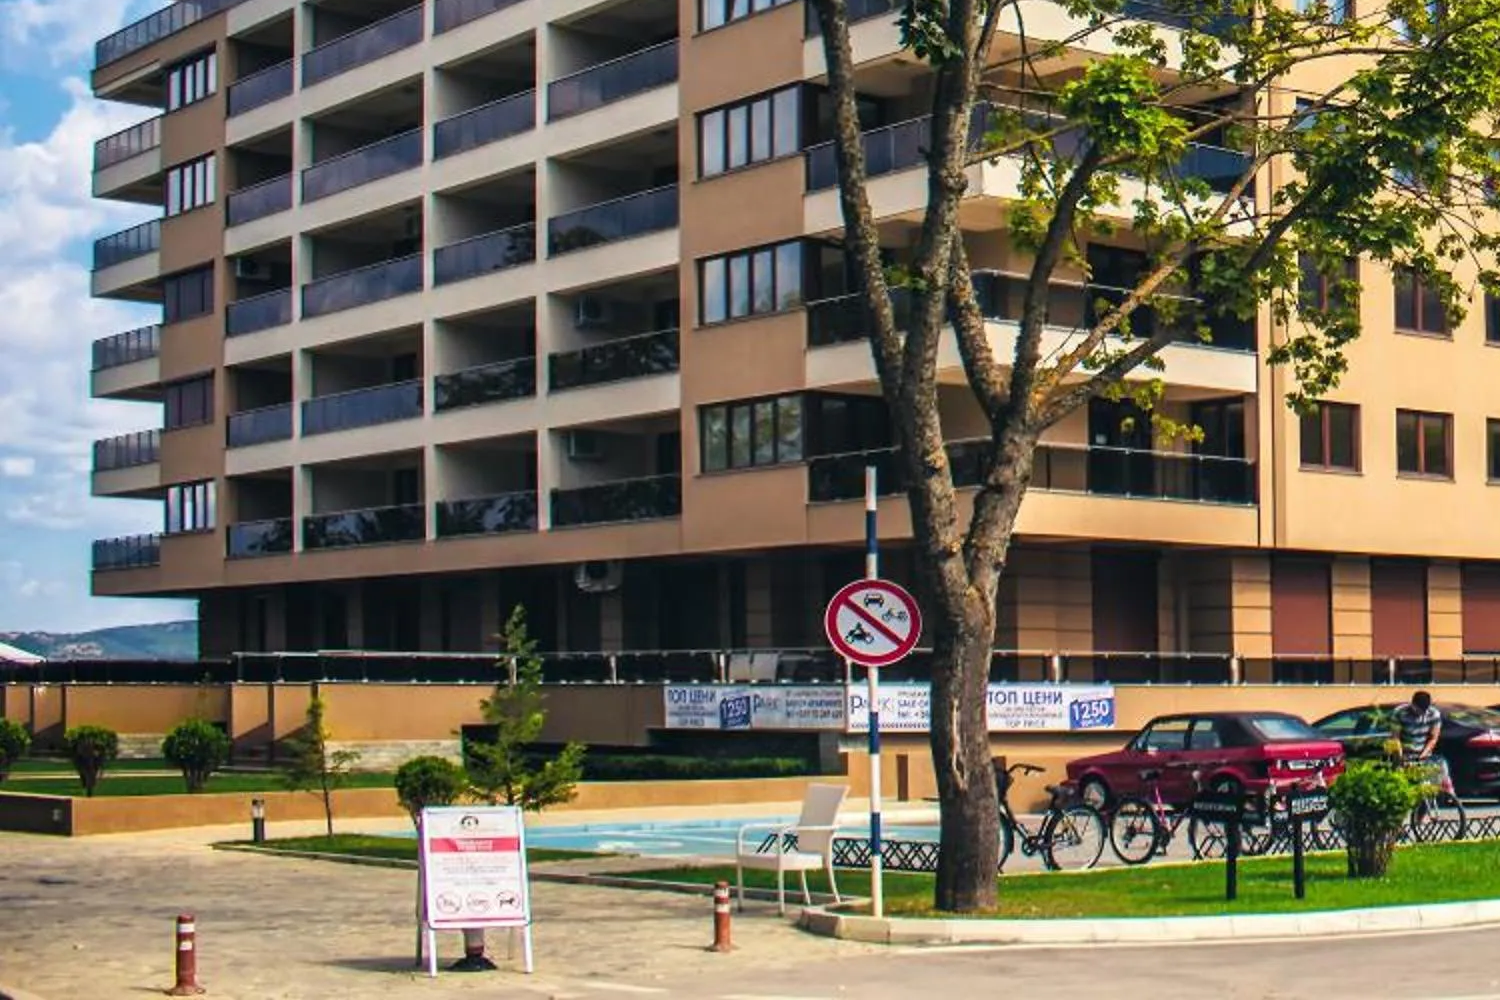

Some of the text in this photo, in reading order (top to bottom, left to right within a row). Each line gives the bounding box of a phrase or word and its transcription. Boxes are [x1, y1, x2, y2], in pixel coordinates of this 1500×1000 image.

[988, 691, 1062, 706] ТОП ЦЕНИ
[1072, 701, 1109, 721] 1250
